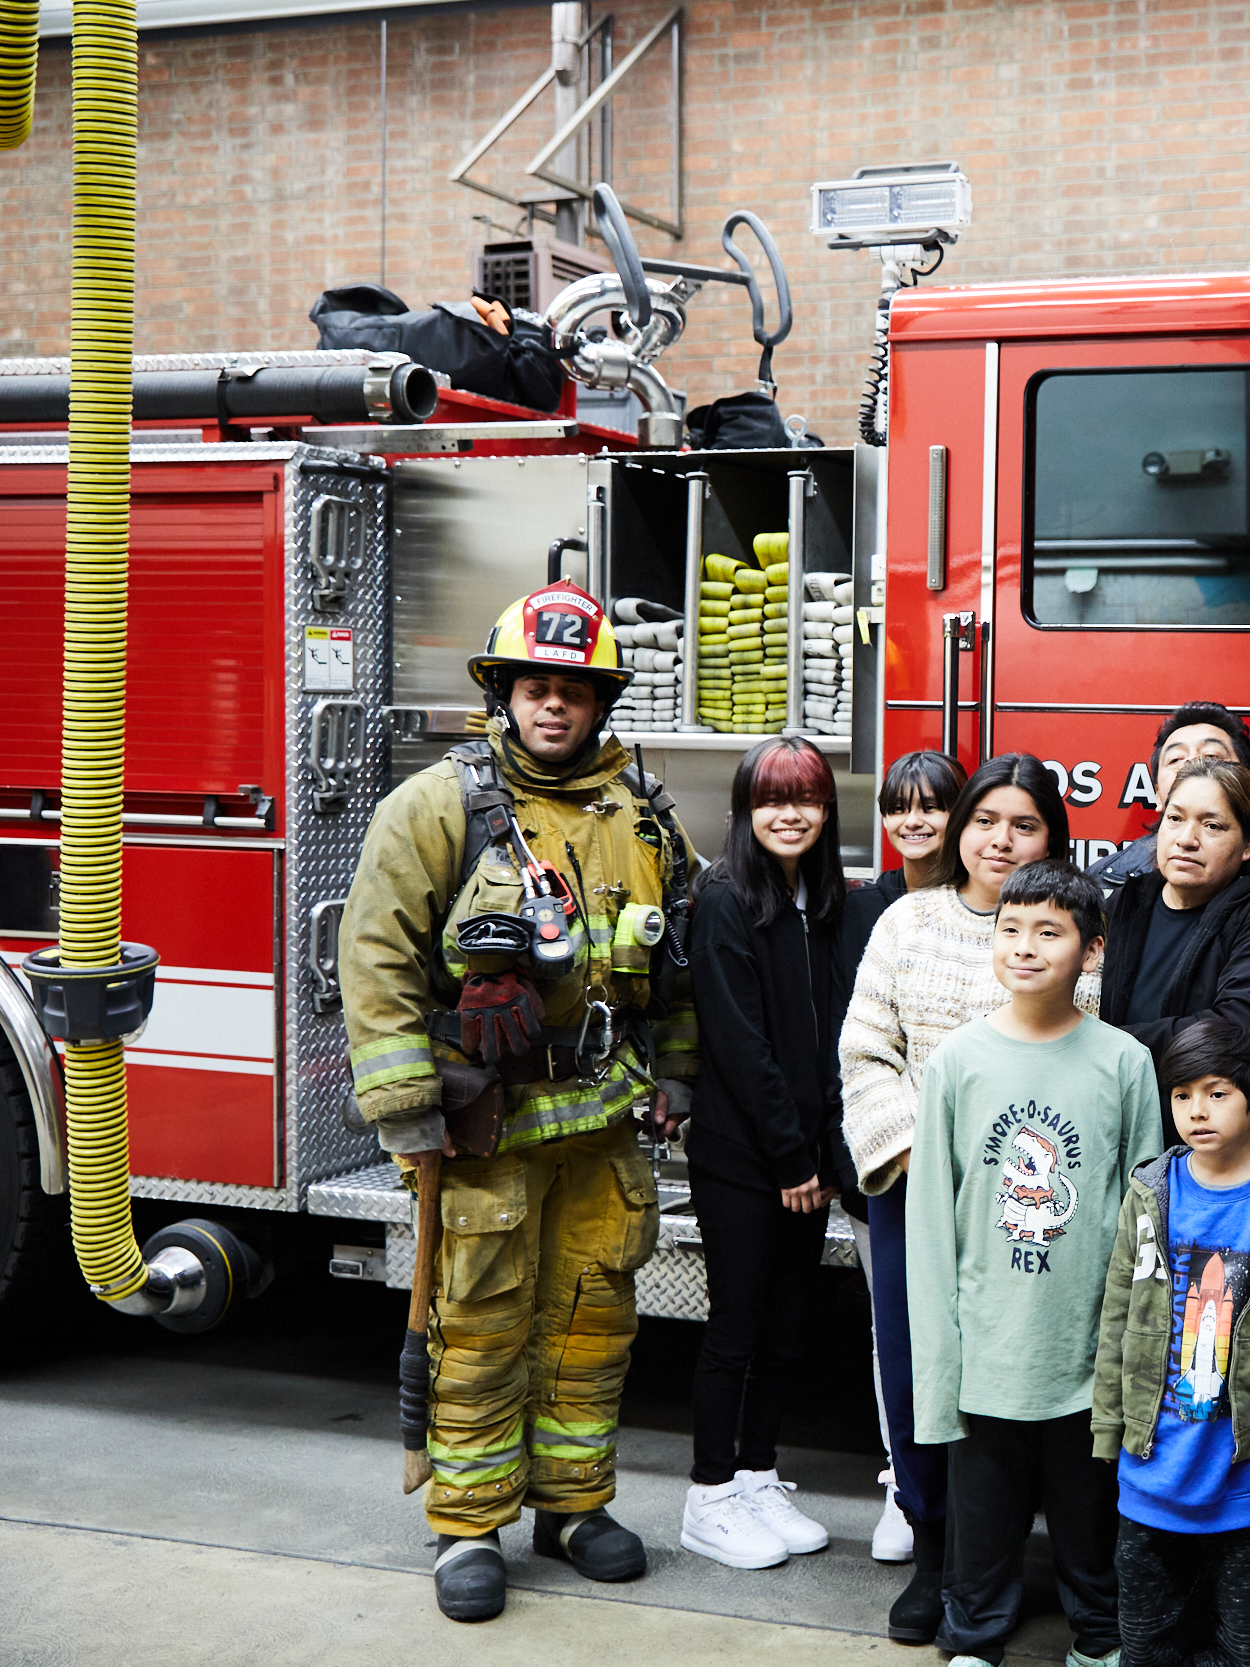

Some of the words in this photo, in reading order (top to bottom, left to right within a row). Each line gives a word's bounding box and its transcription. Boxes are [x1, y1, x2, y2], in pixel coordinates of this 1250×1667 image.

[537, 595, 593, 611] FIREFIGHTER
[543, 612, 577, 644] 72
[544, 650, 576, 659] LAFD
[1041, 759, 1103, 803] OS
[1011, 1247, 1051, 1275] REX
